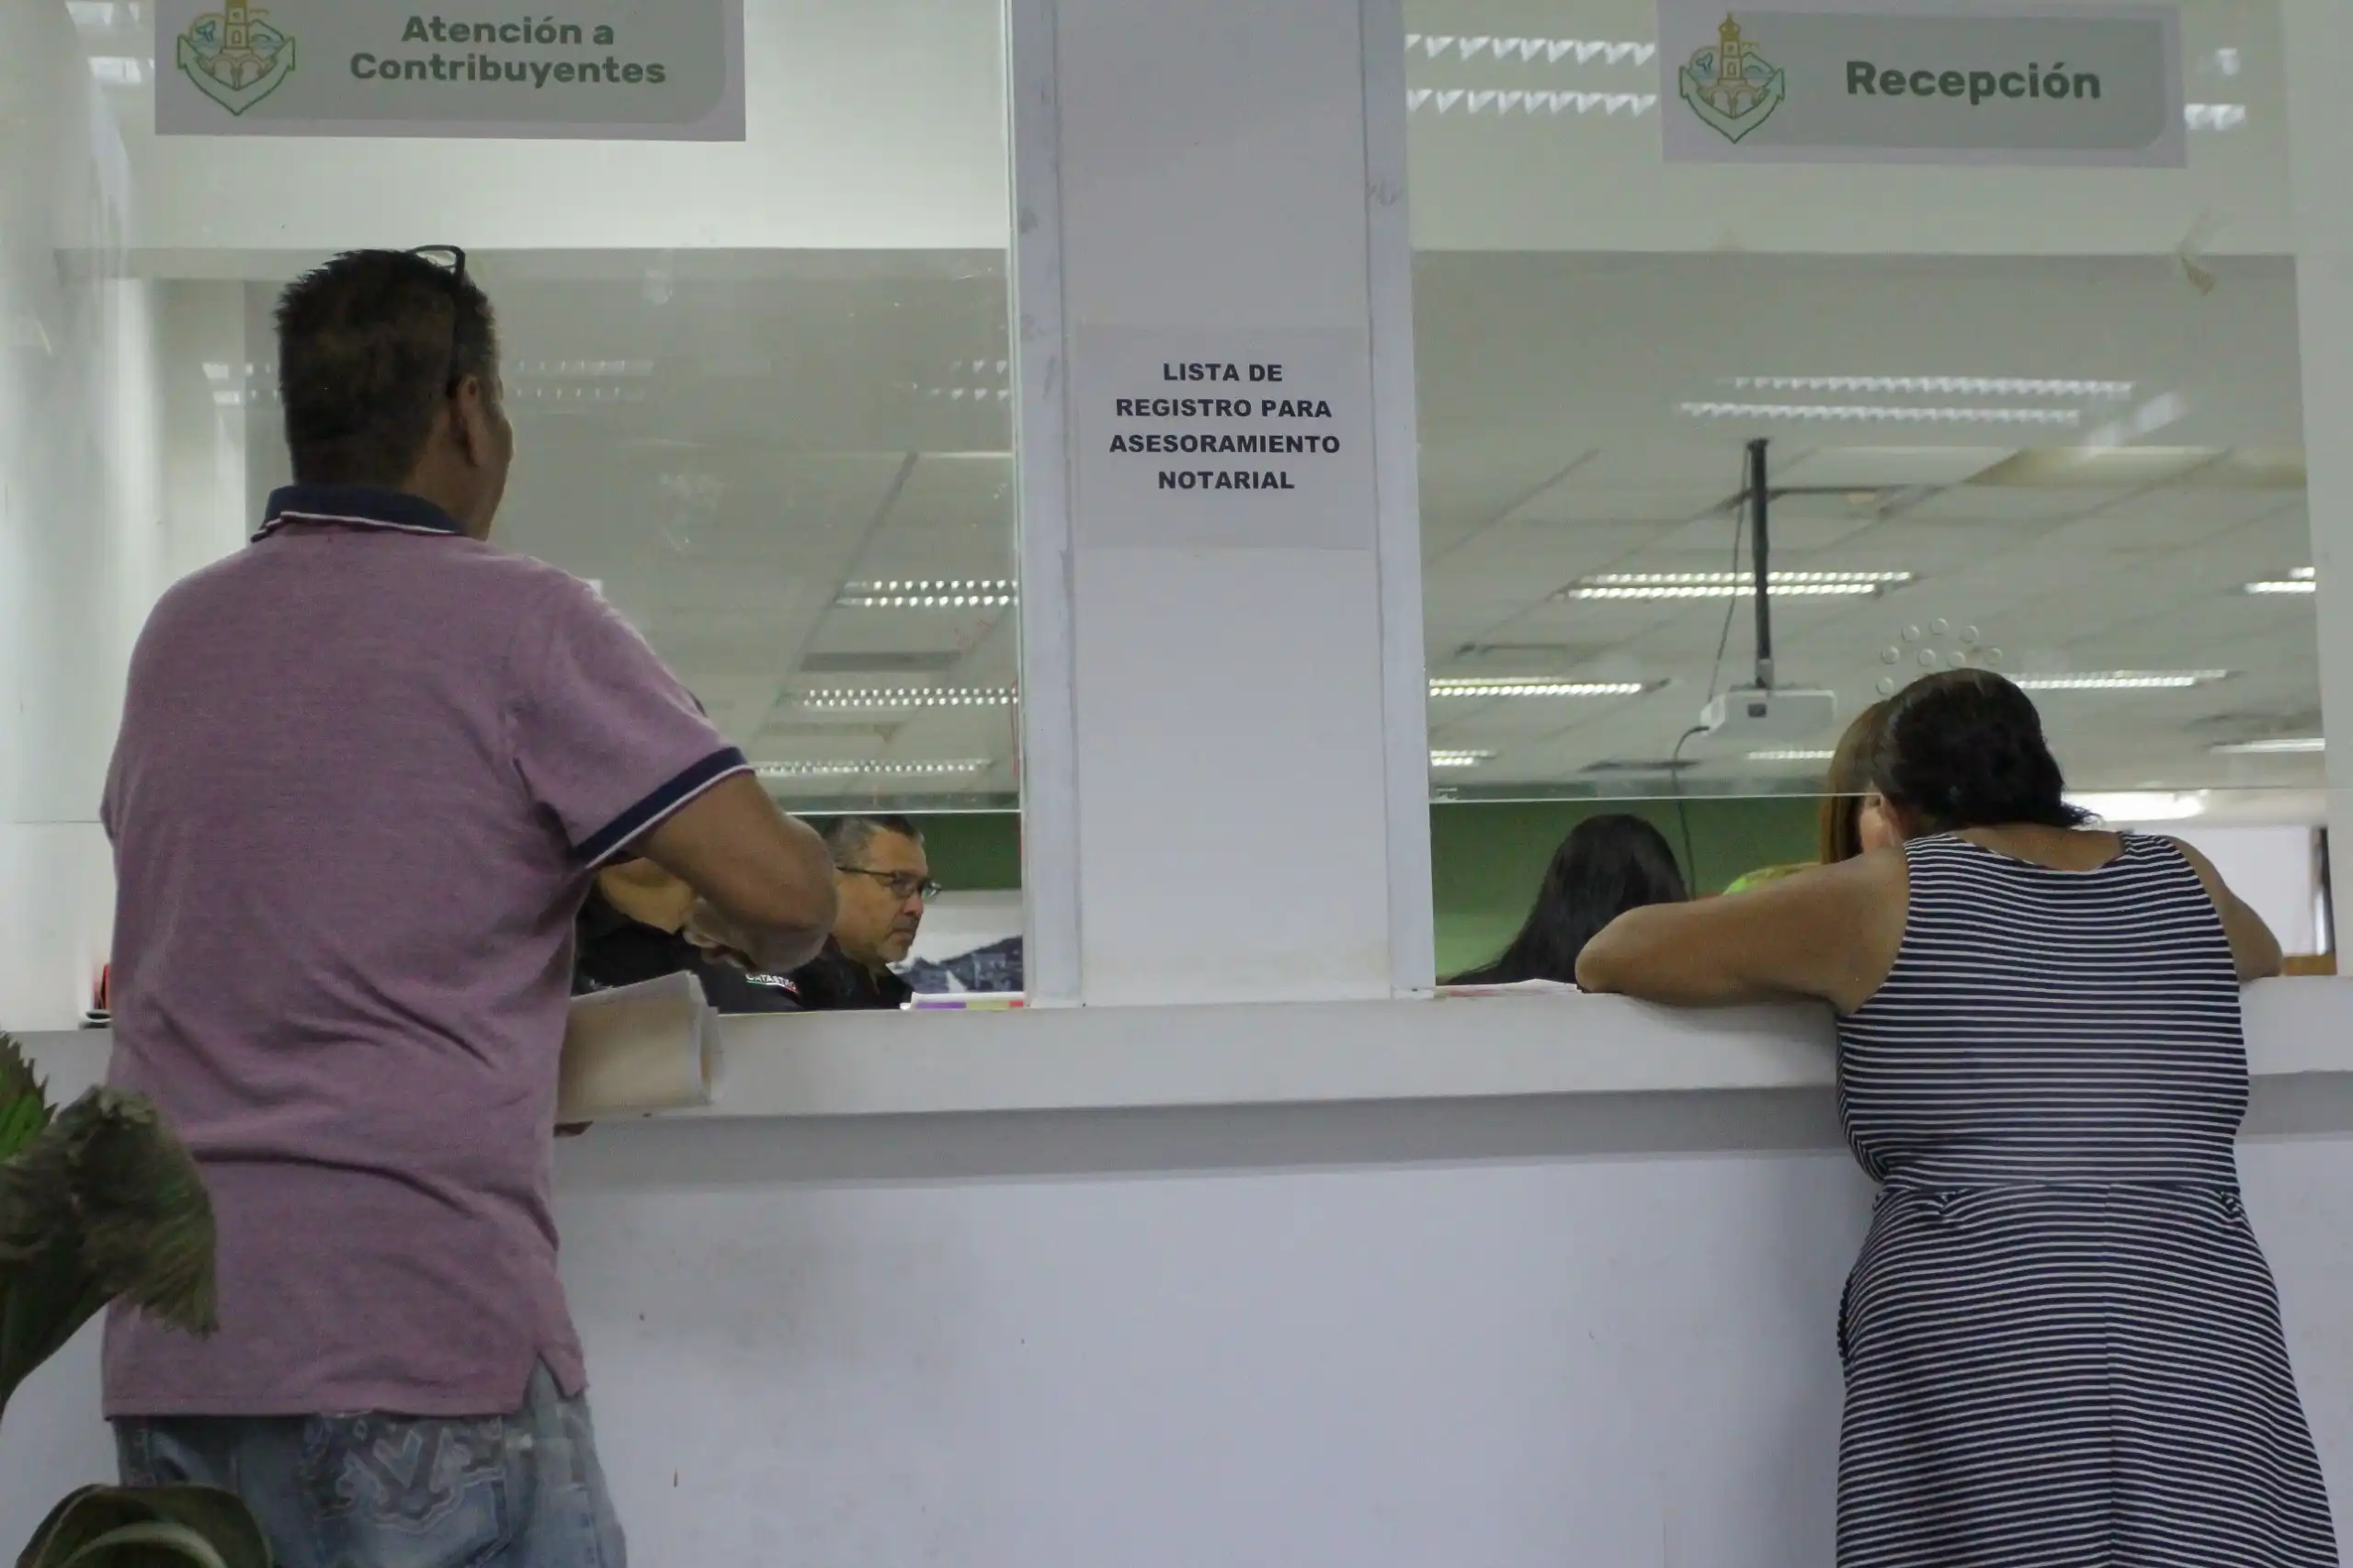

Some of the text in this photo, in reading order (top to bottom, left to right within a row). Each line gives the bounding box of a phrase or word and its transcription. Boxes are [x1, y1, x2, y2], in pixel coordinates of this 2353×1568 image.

[401, 16, 614, 45] Atención a
[350, 52, 666, 89] Contribuyentes
[1846, 60, 2101, 106] Recepción
[1163, 363, 1283, 382] LISTA DE
[1116, 398, 1333, 418] REGISTRO PARA
[1109, 434, 1340, 453] ASESORAMIENTO
[1158, 471, 1295, 489] NOTARIAL
